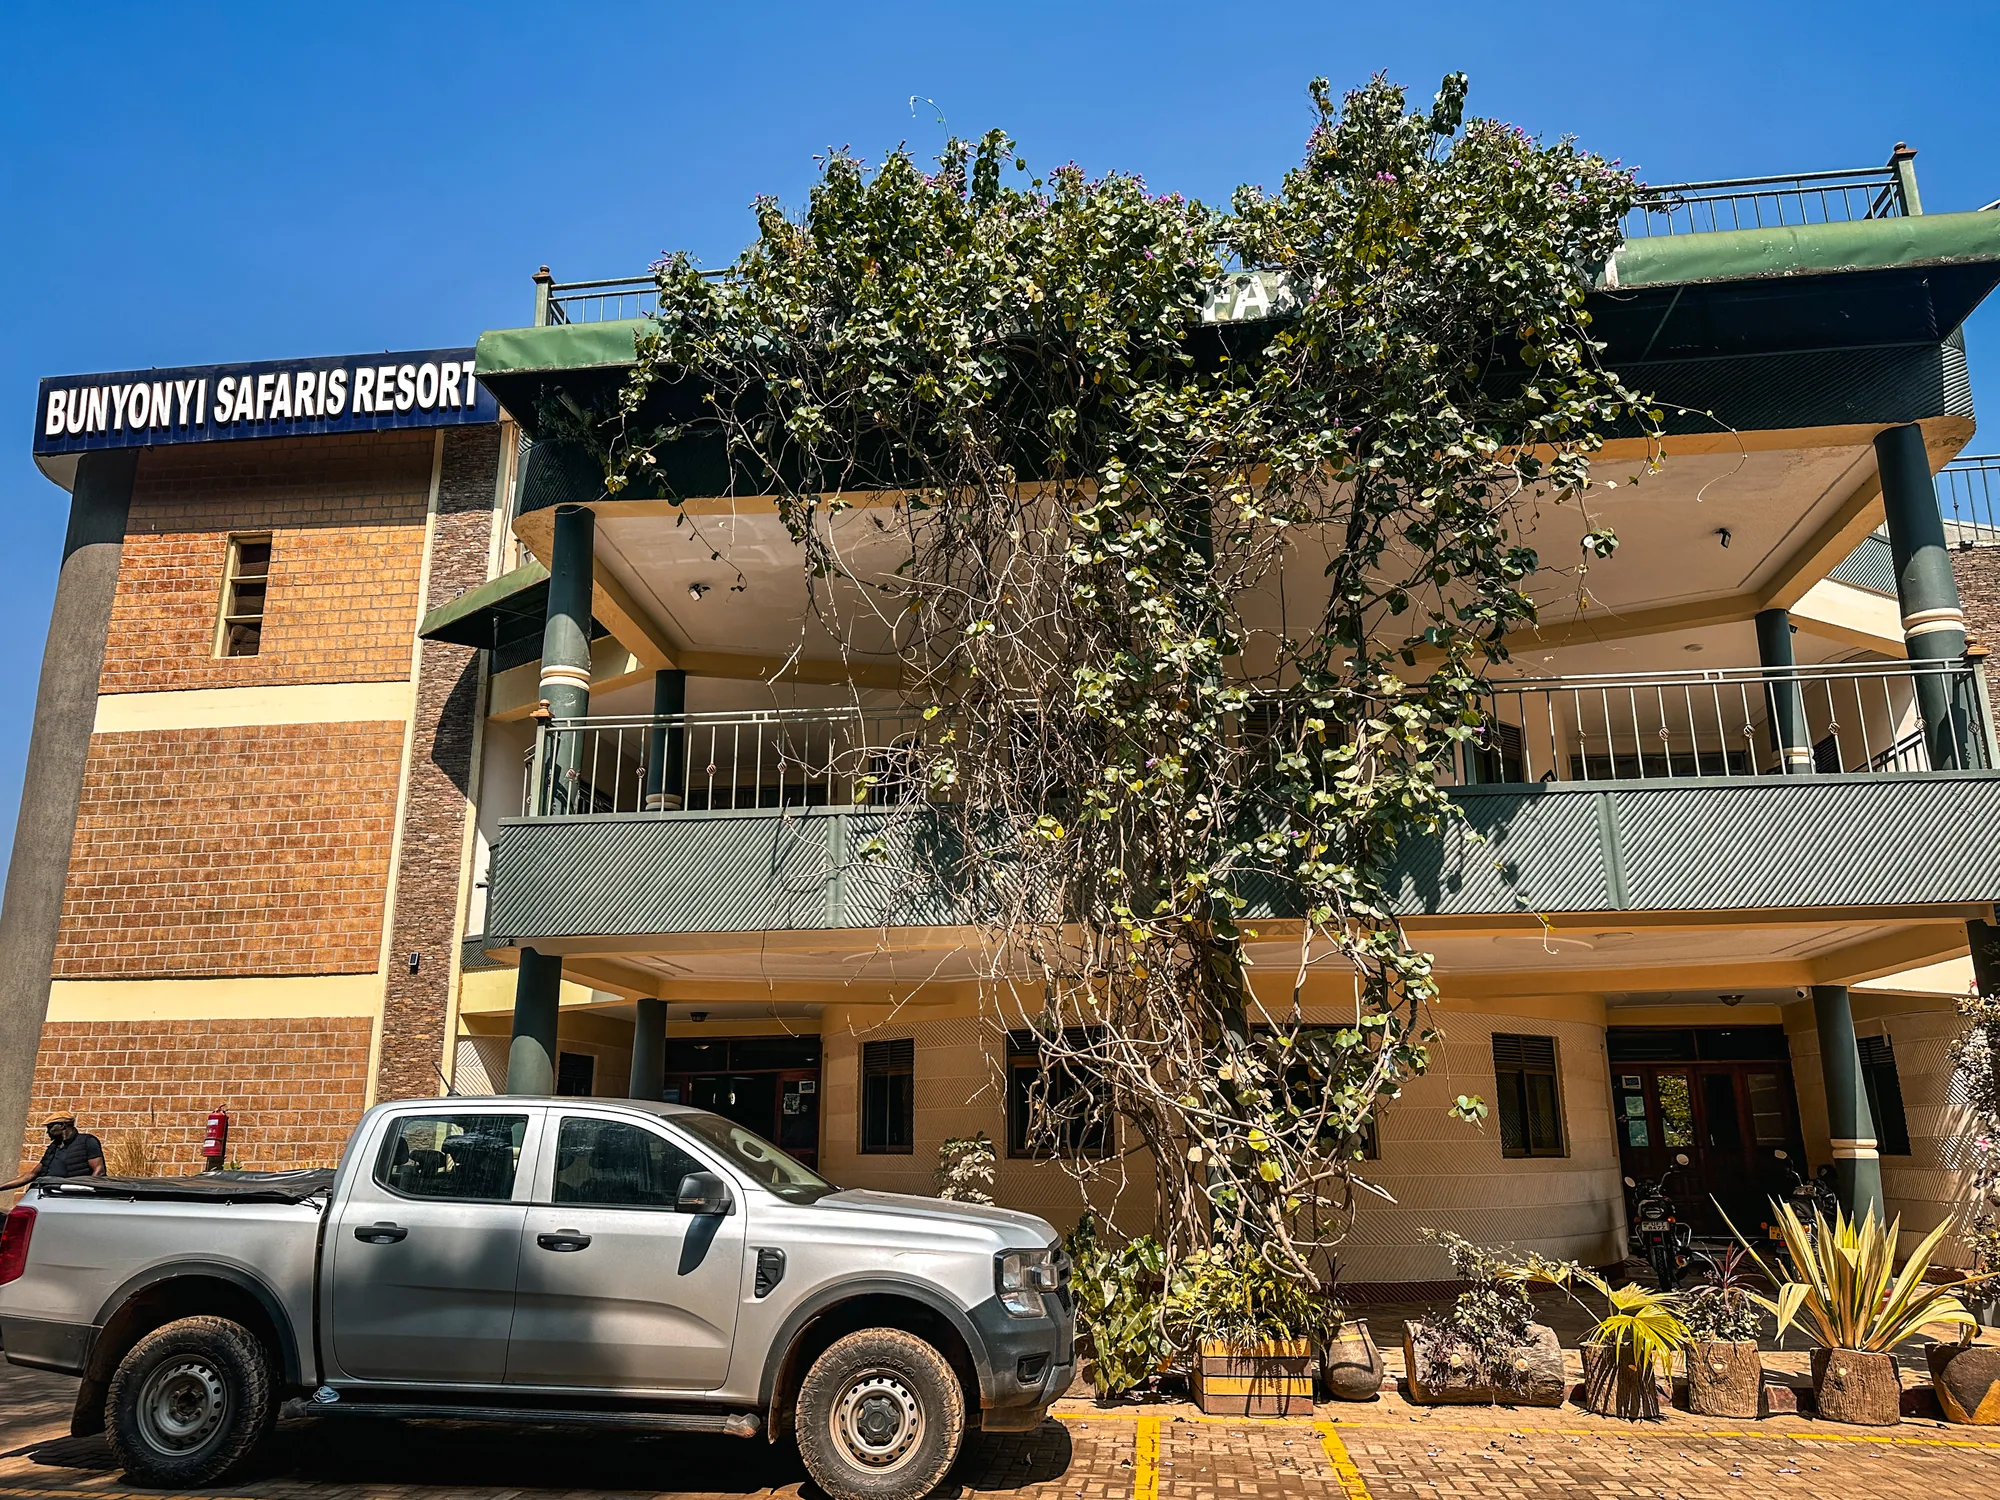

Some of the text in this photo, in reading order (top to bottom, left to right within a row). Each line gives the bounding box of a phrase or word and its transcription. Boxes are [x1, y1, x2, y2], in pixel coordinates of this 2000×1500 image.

[45, 360, 477, 437] BUNYONYI SAFARIS RESORT
[839, 1356, 916, 1378] SAHARA
